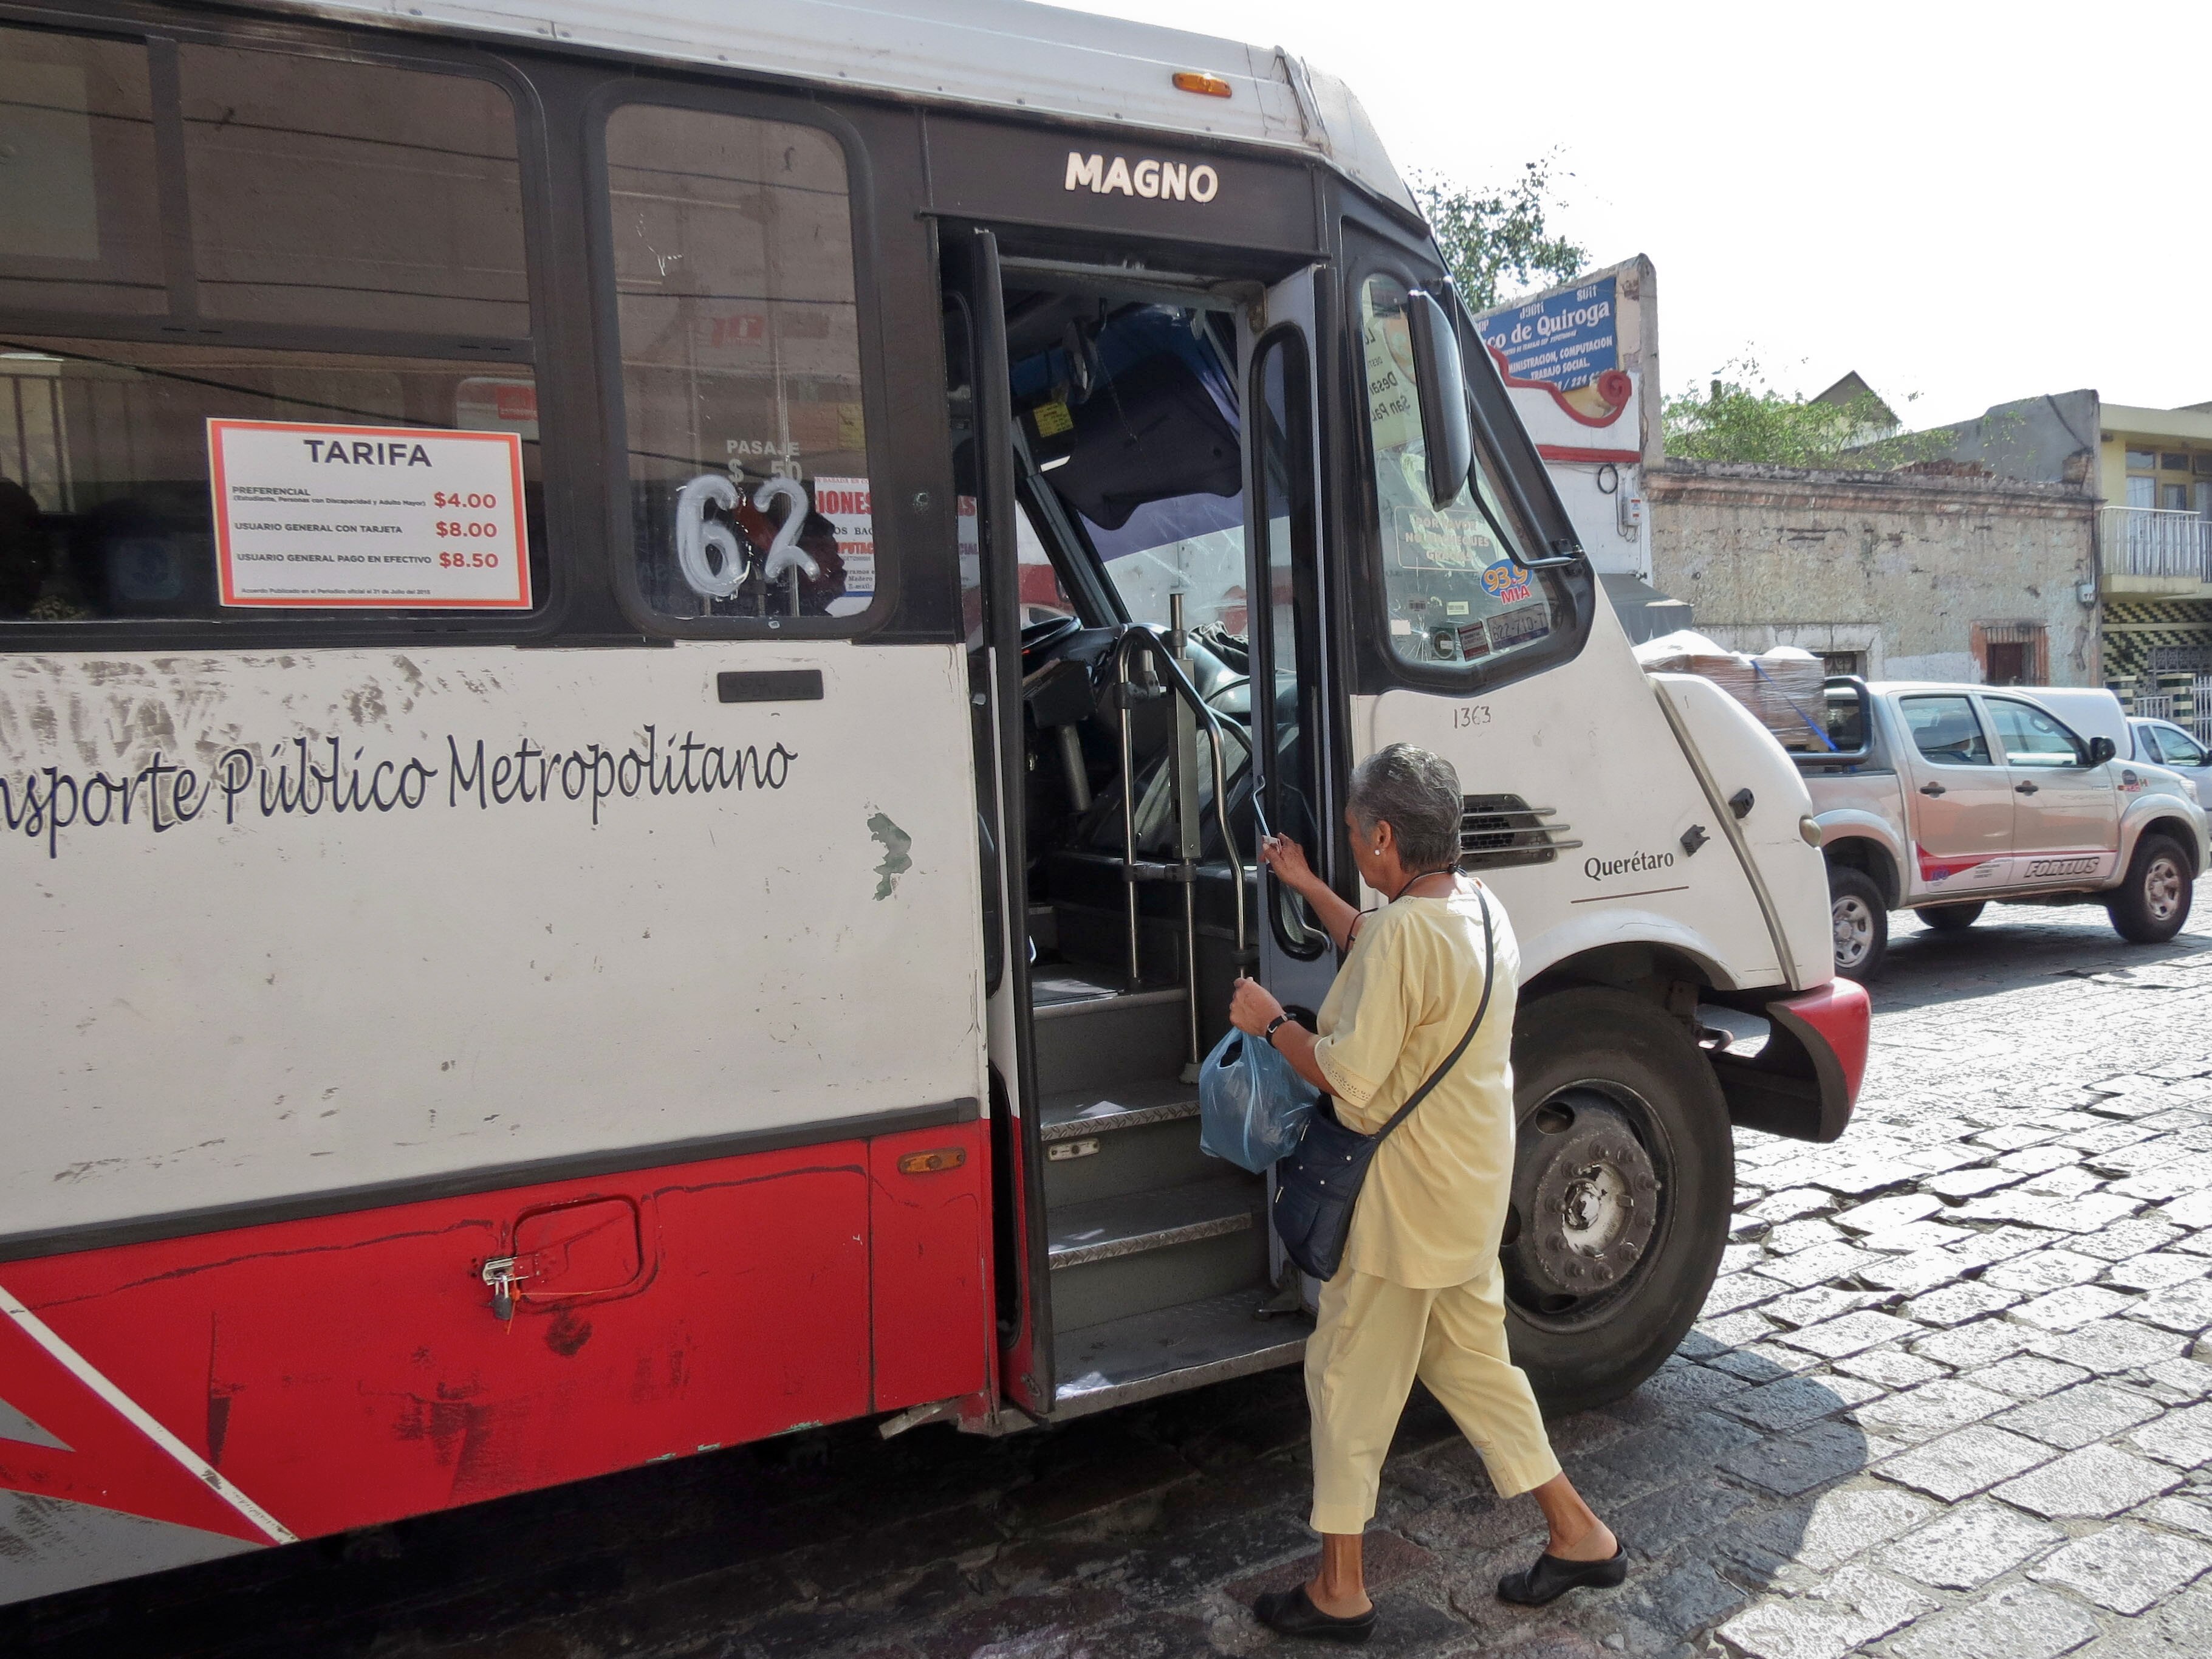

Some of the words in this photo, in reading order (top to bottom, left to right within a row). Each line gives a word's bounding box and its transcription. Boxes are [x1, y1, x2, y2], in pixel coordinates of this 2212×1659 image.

[1064, 151, 1219, 203] MAGNO
[1511, 323, 1532, 343] de
[1537, 301, 1610, 337] Quiroga
[1560, 335, 1613, 359] COMPUTACION
[1530, 363, 1562, 380] TRABAJO
[1563, 357, 1591, 373] SOCIAL.
[303, 439, 433, 467] TARIFA
[727, 440, 800, 456] PASAJE
[728, 458, 744, 484] $
[232, 486, 311, 496] PREFERENCIAL
[434, 491, 496, 509] $4.00
[235, 523, 282, 531] USUARIO
[285, 524, 332, 532] GENERAL
[436, 521, 497, 538] $8.00
[1416, 517, 1439, 528] POR
[676, 474, 820, 597] 62
[1405, 532, 1423, 543] NO
[237, 553, 284, 562] USUARIO
[287, 554, 335, 563] GENERAL
[439, 552, 499, 568] $8.50
[1484, 565, 1529, 592] 93.9
[1500, 585, 1532, 605] MIA
[1454, 706, 1491, 729] 1363
[1584, 850, 1674, 882] Querétaro
[2024, 857, 2099, 878] FORTIUS
